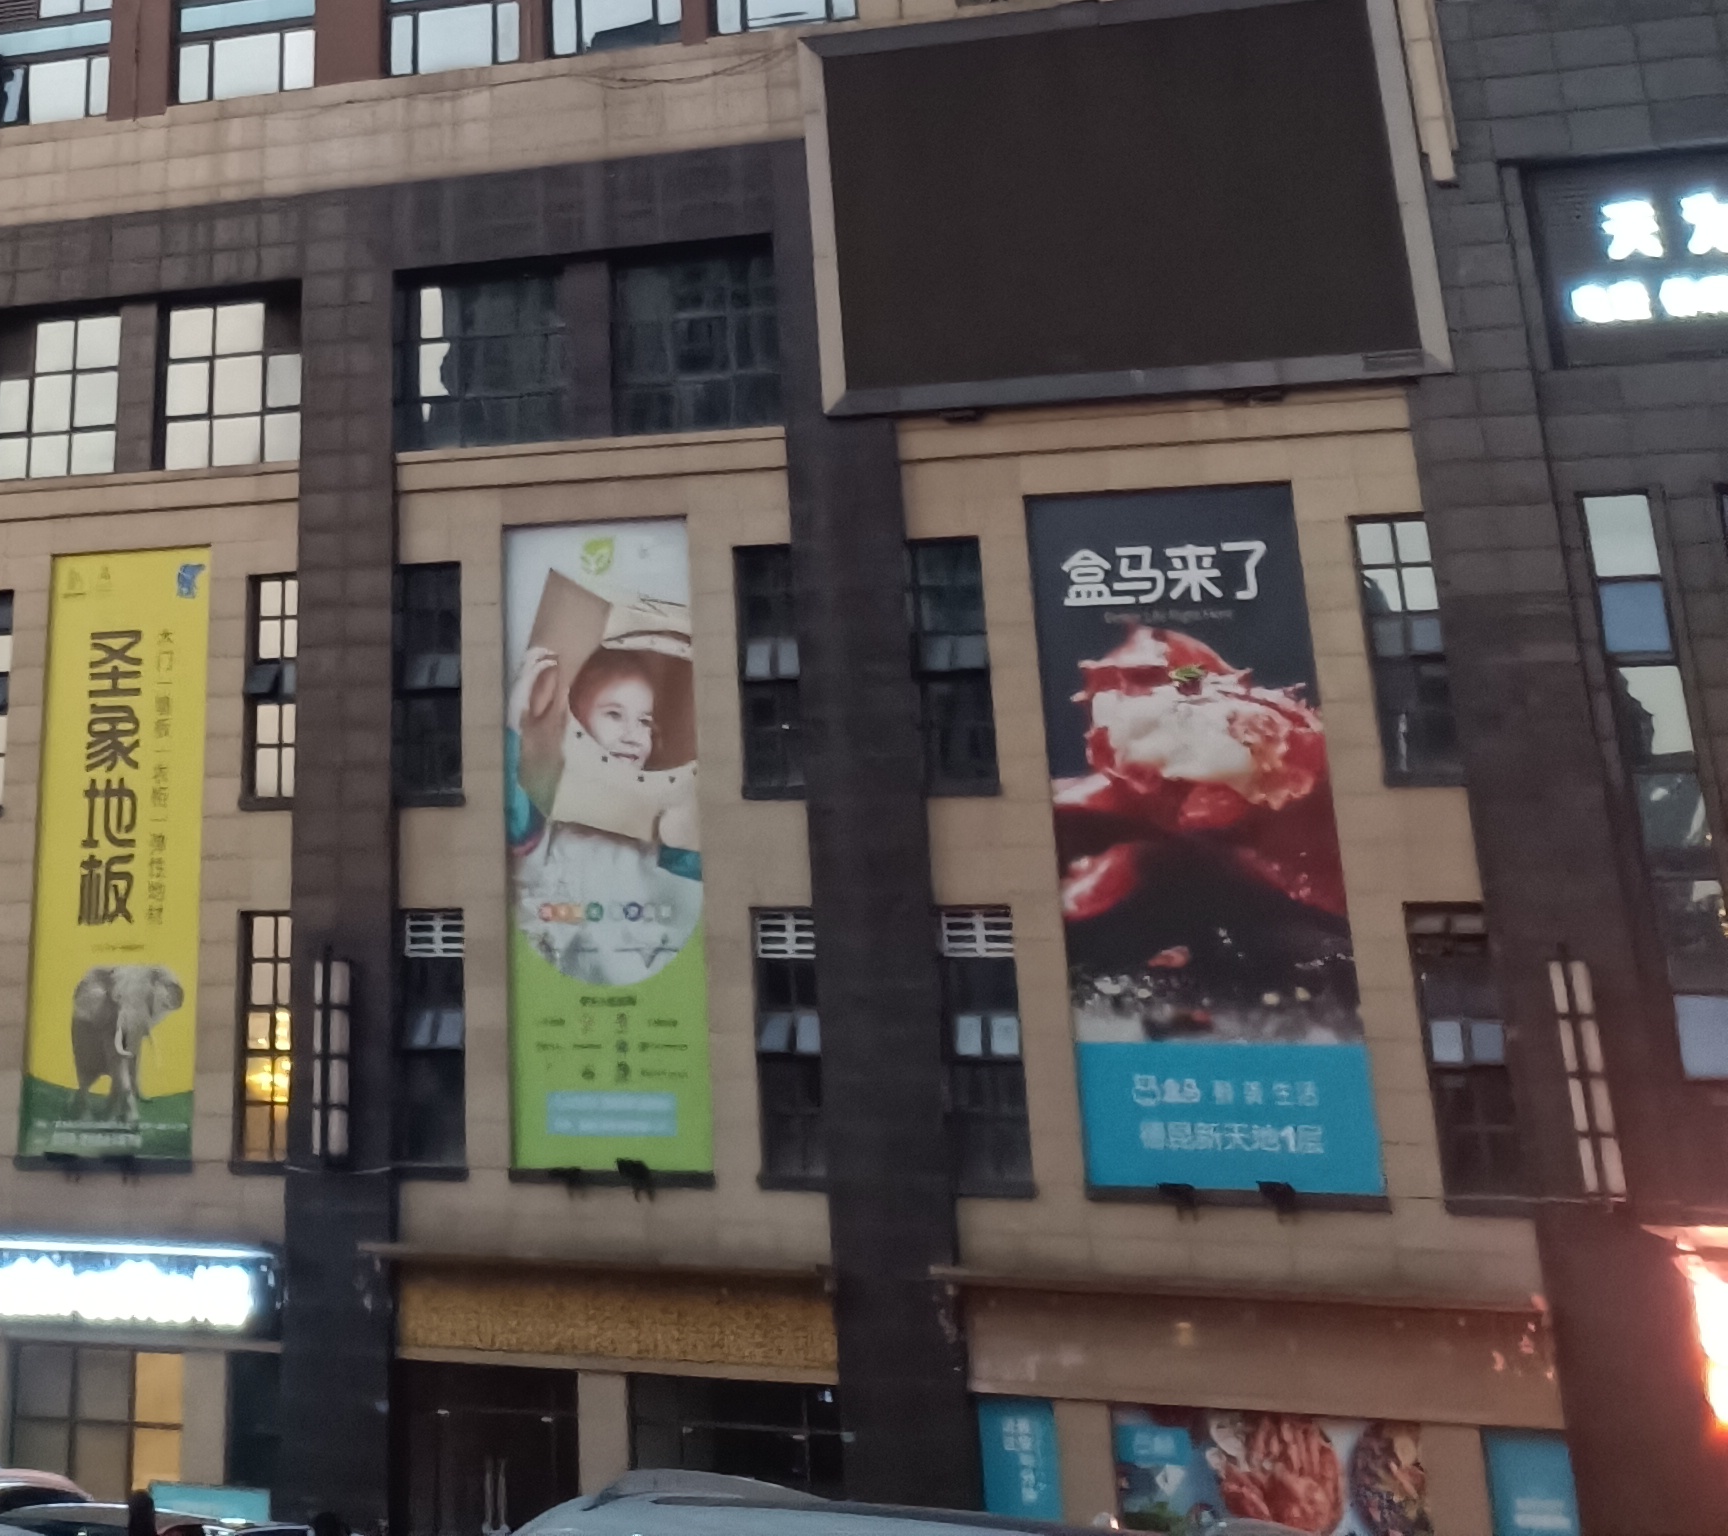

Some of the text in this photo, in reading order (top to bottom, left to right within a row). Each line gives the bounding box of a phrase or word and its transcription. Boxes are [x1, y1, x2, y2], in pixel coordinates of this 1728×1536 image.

[1061, 540, 1267, 606] 盒马来了
[77, 629, 142, 926] 圣象地板
